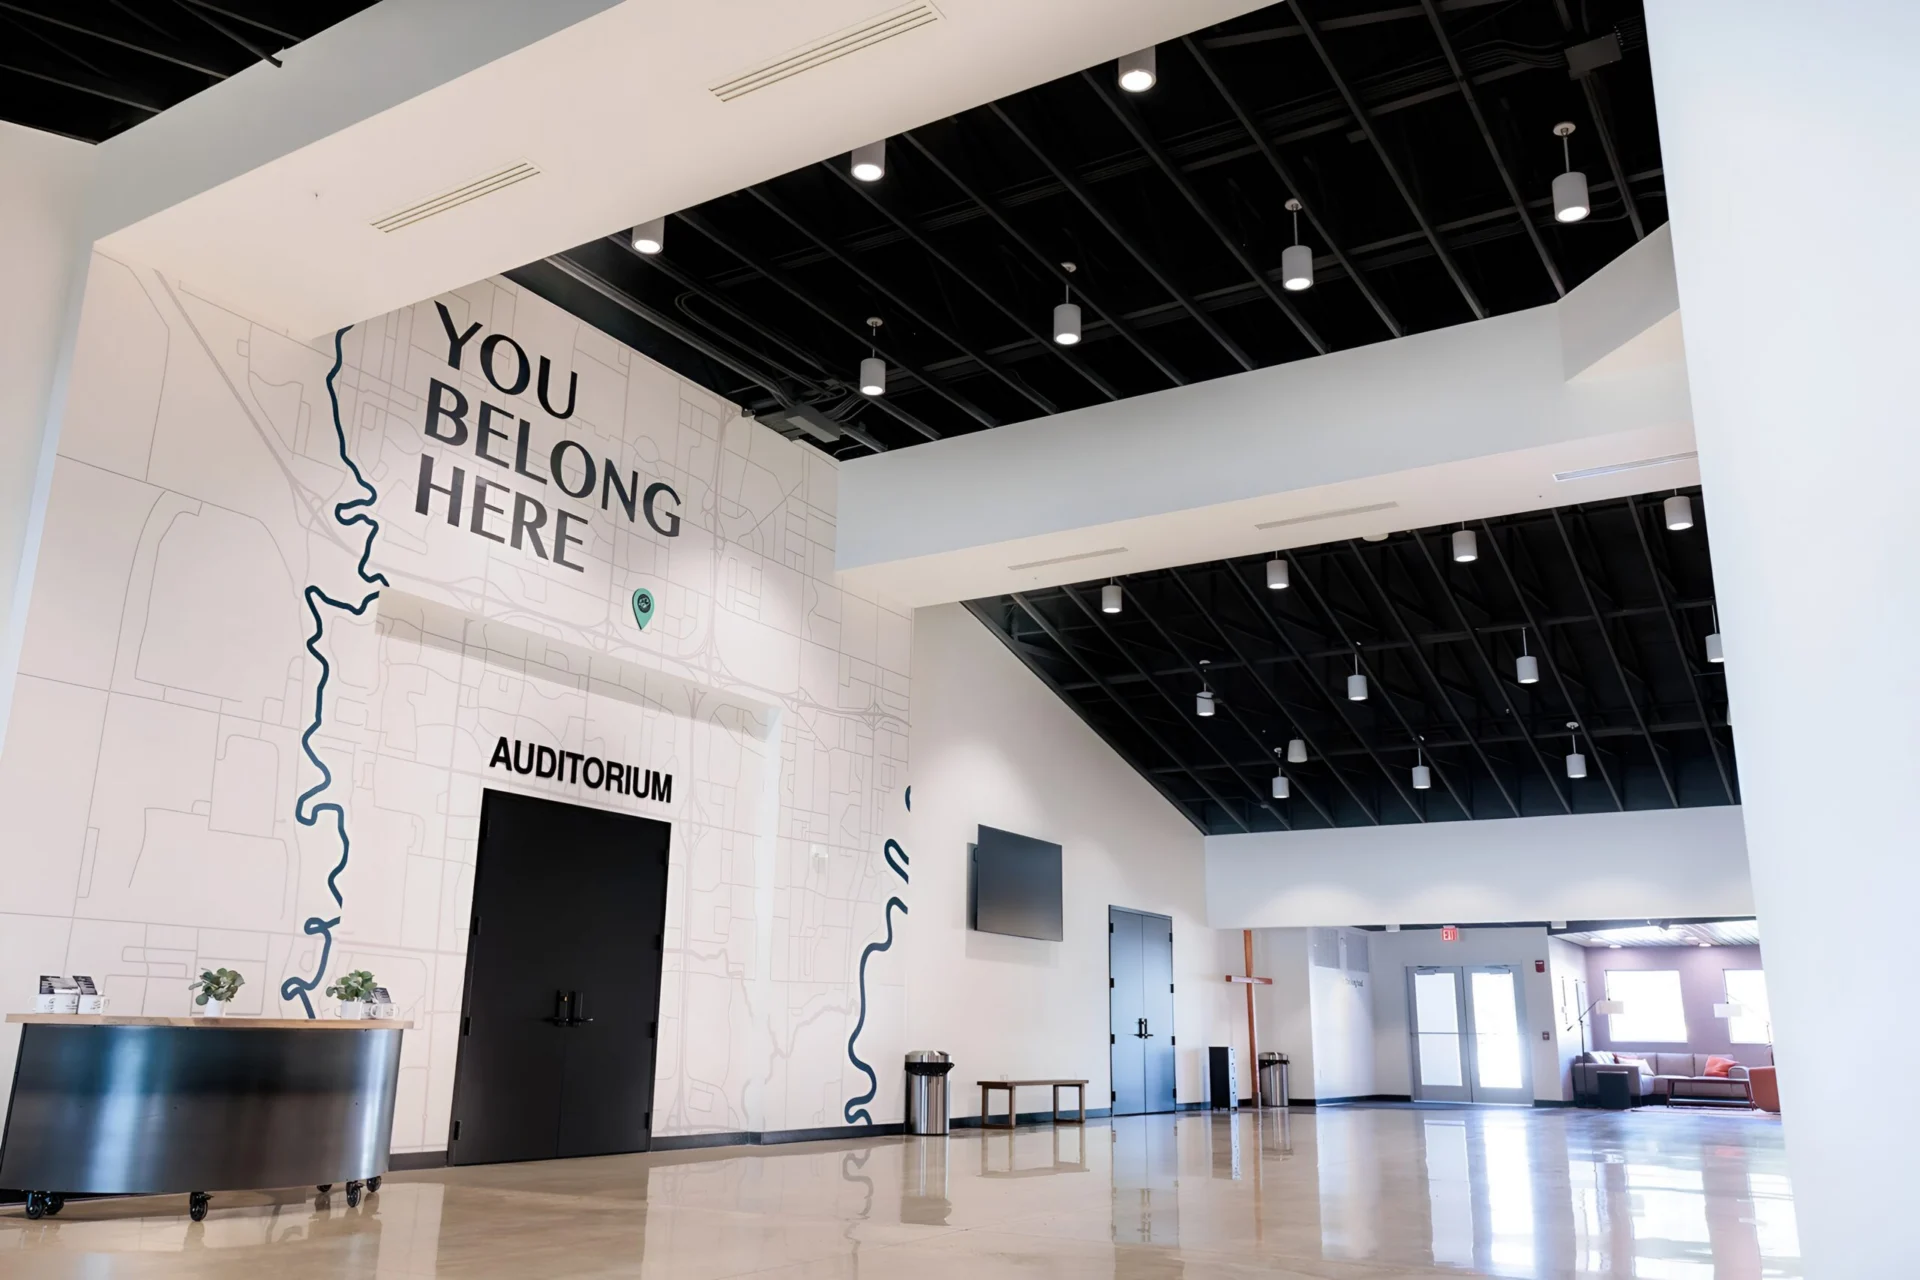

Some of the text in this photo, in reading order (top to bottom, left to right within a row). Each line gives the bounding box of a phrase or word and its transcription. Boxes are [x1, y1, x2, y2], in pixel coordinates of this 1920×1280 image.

[434, 300, 578, 420] YOU
[415, 453, 588, 573] HERE
[424, 377, 682, 538] BELONG
[489, 736, 672, 803] AUDITORIUM
